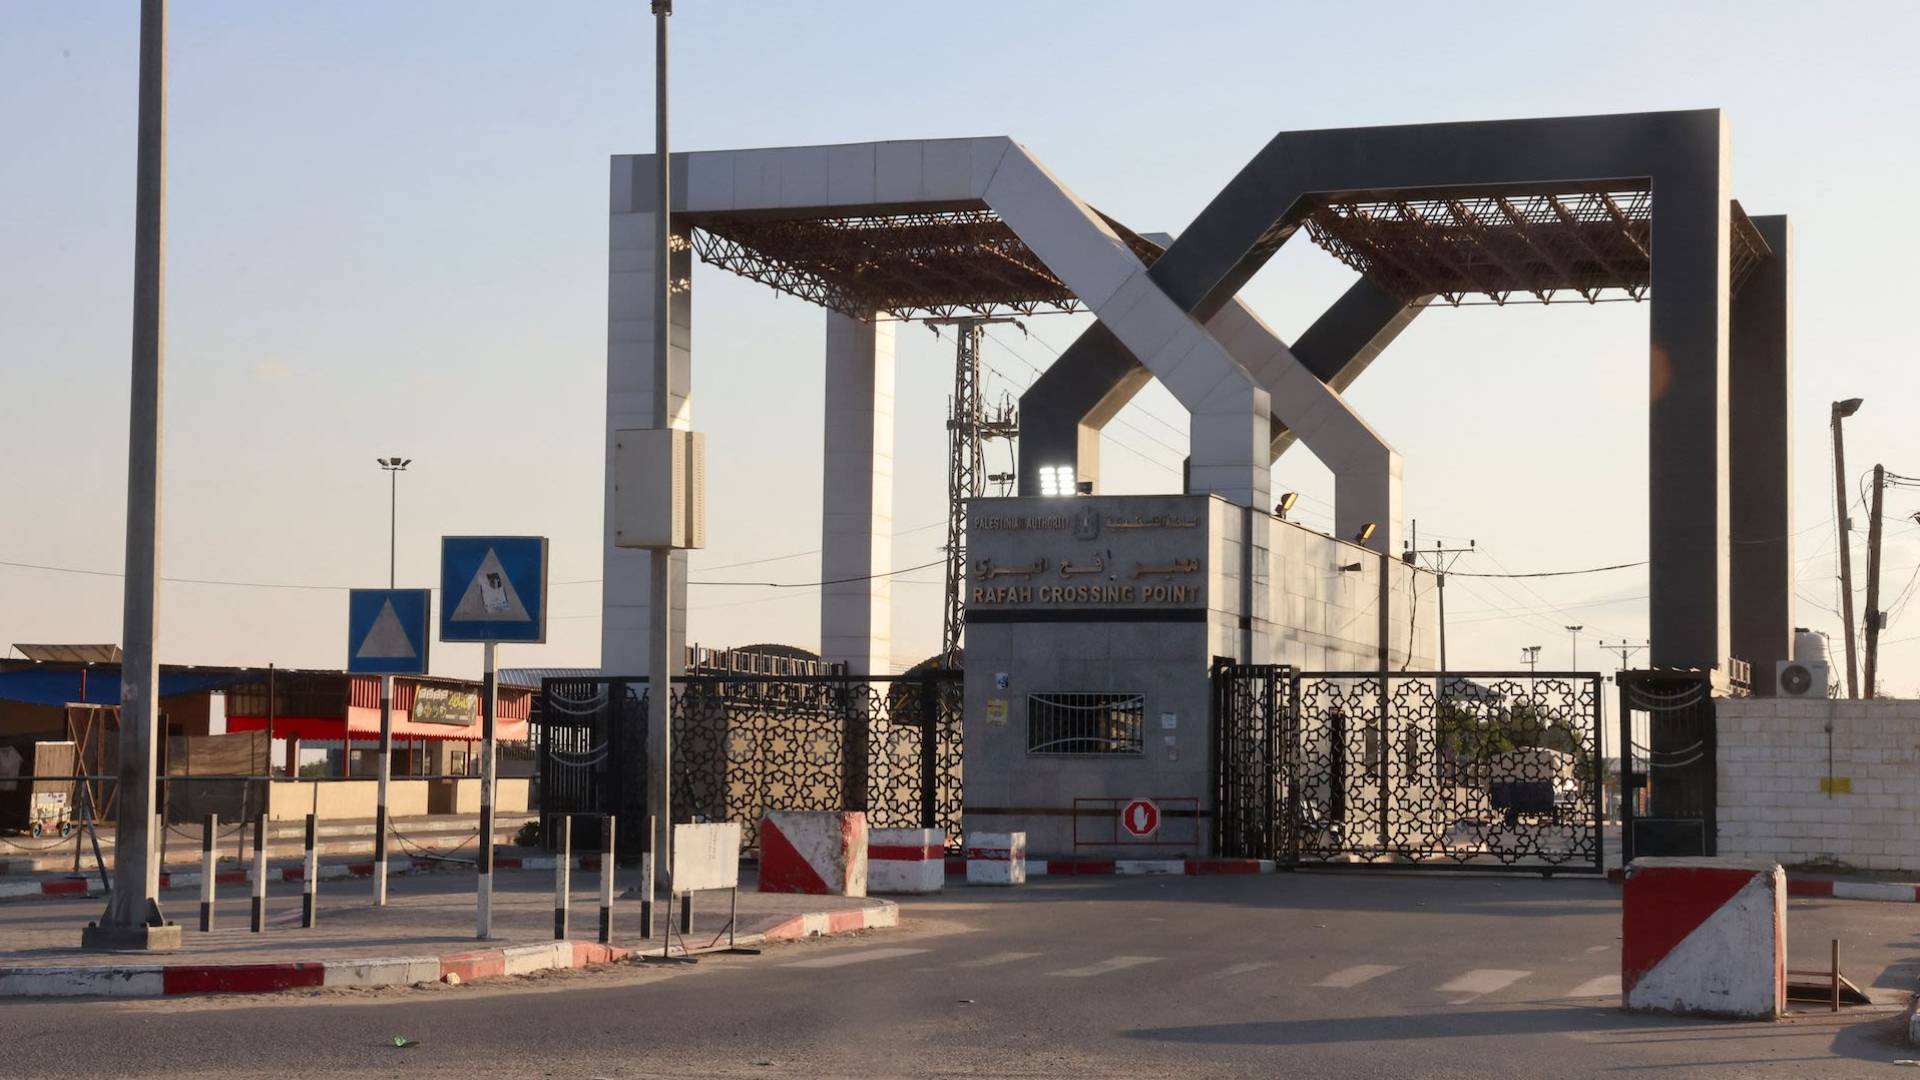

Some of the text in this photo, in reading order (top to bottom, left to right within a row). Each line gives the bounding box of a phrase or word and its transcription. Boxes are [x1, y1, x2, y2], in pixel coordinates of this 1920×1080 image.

[1059, 550, 1112, 580] فح
[973, 586, 1200, 603] RAFAH CROSSING POINT
